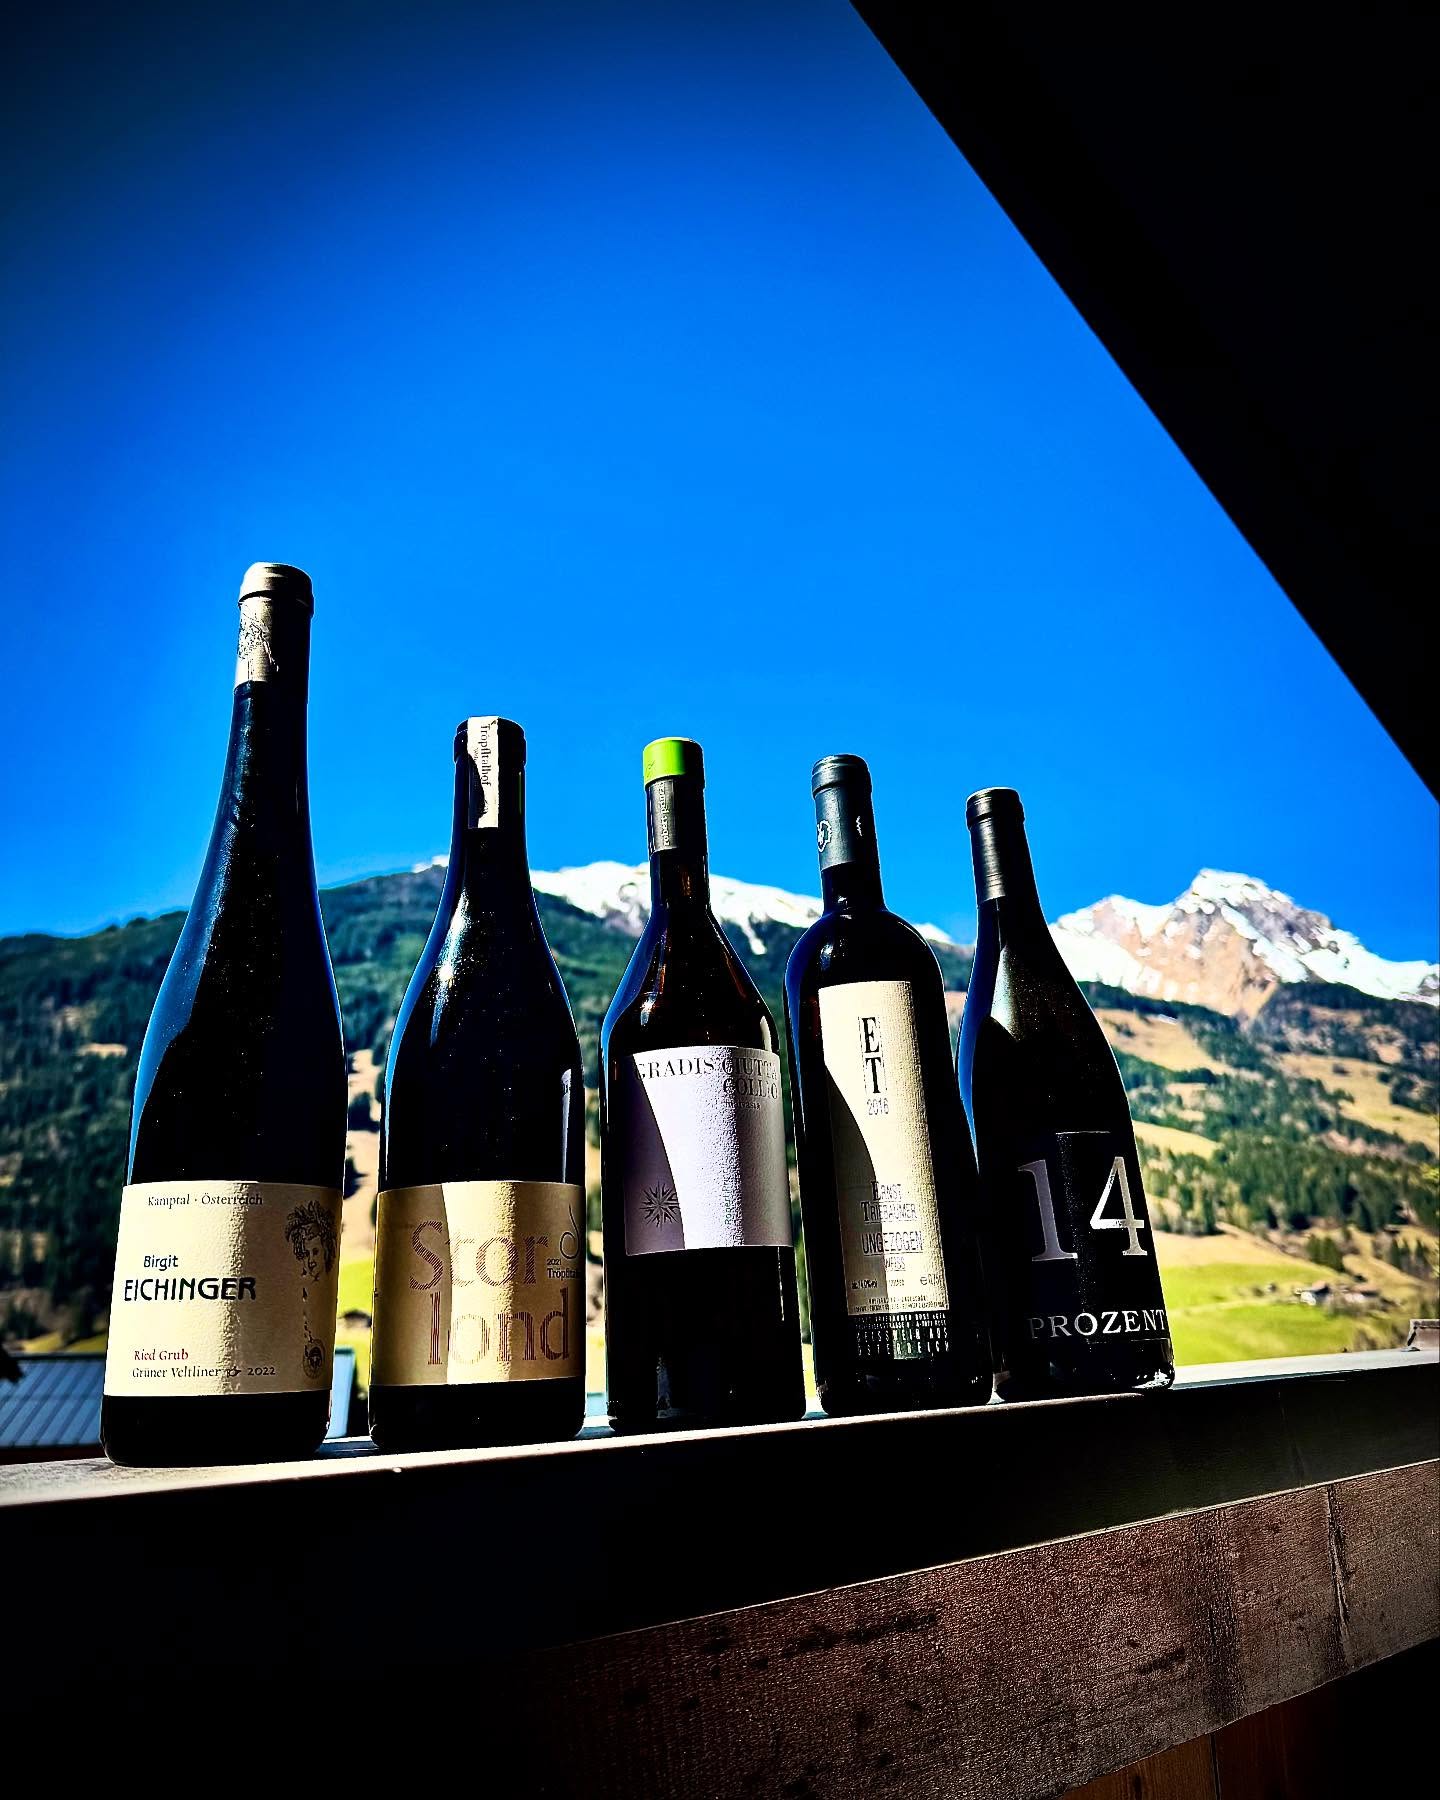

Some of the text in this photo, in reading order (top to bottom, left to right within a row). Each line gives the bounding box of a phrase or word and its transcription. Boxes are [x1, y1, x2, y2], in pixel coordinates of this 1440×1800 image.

[147, 1193, 263, 1210] Kamptal Österreich
[1017, 1156, 1148, 1261] 14
[143, 1254, 179, 1271] Birgit
[124, 1276, 257, 1301] EICHINGER
[1027, 1308, 1167, 1339] PROZENT
[134, 1348, 189, 1361] Ried Grub
[132, 1365, 276, 1378] Grüner Veltliner 2022
